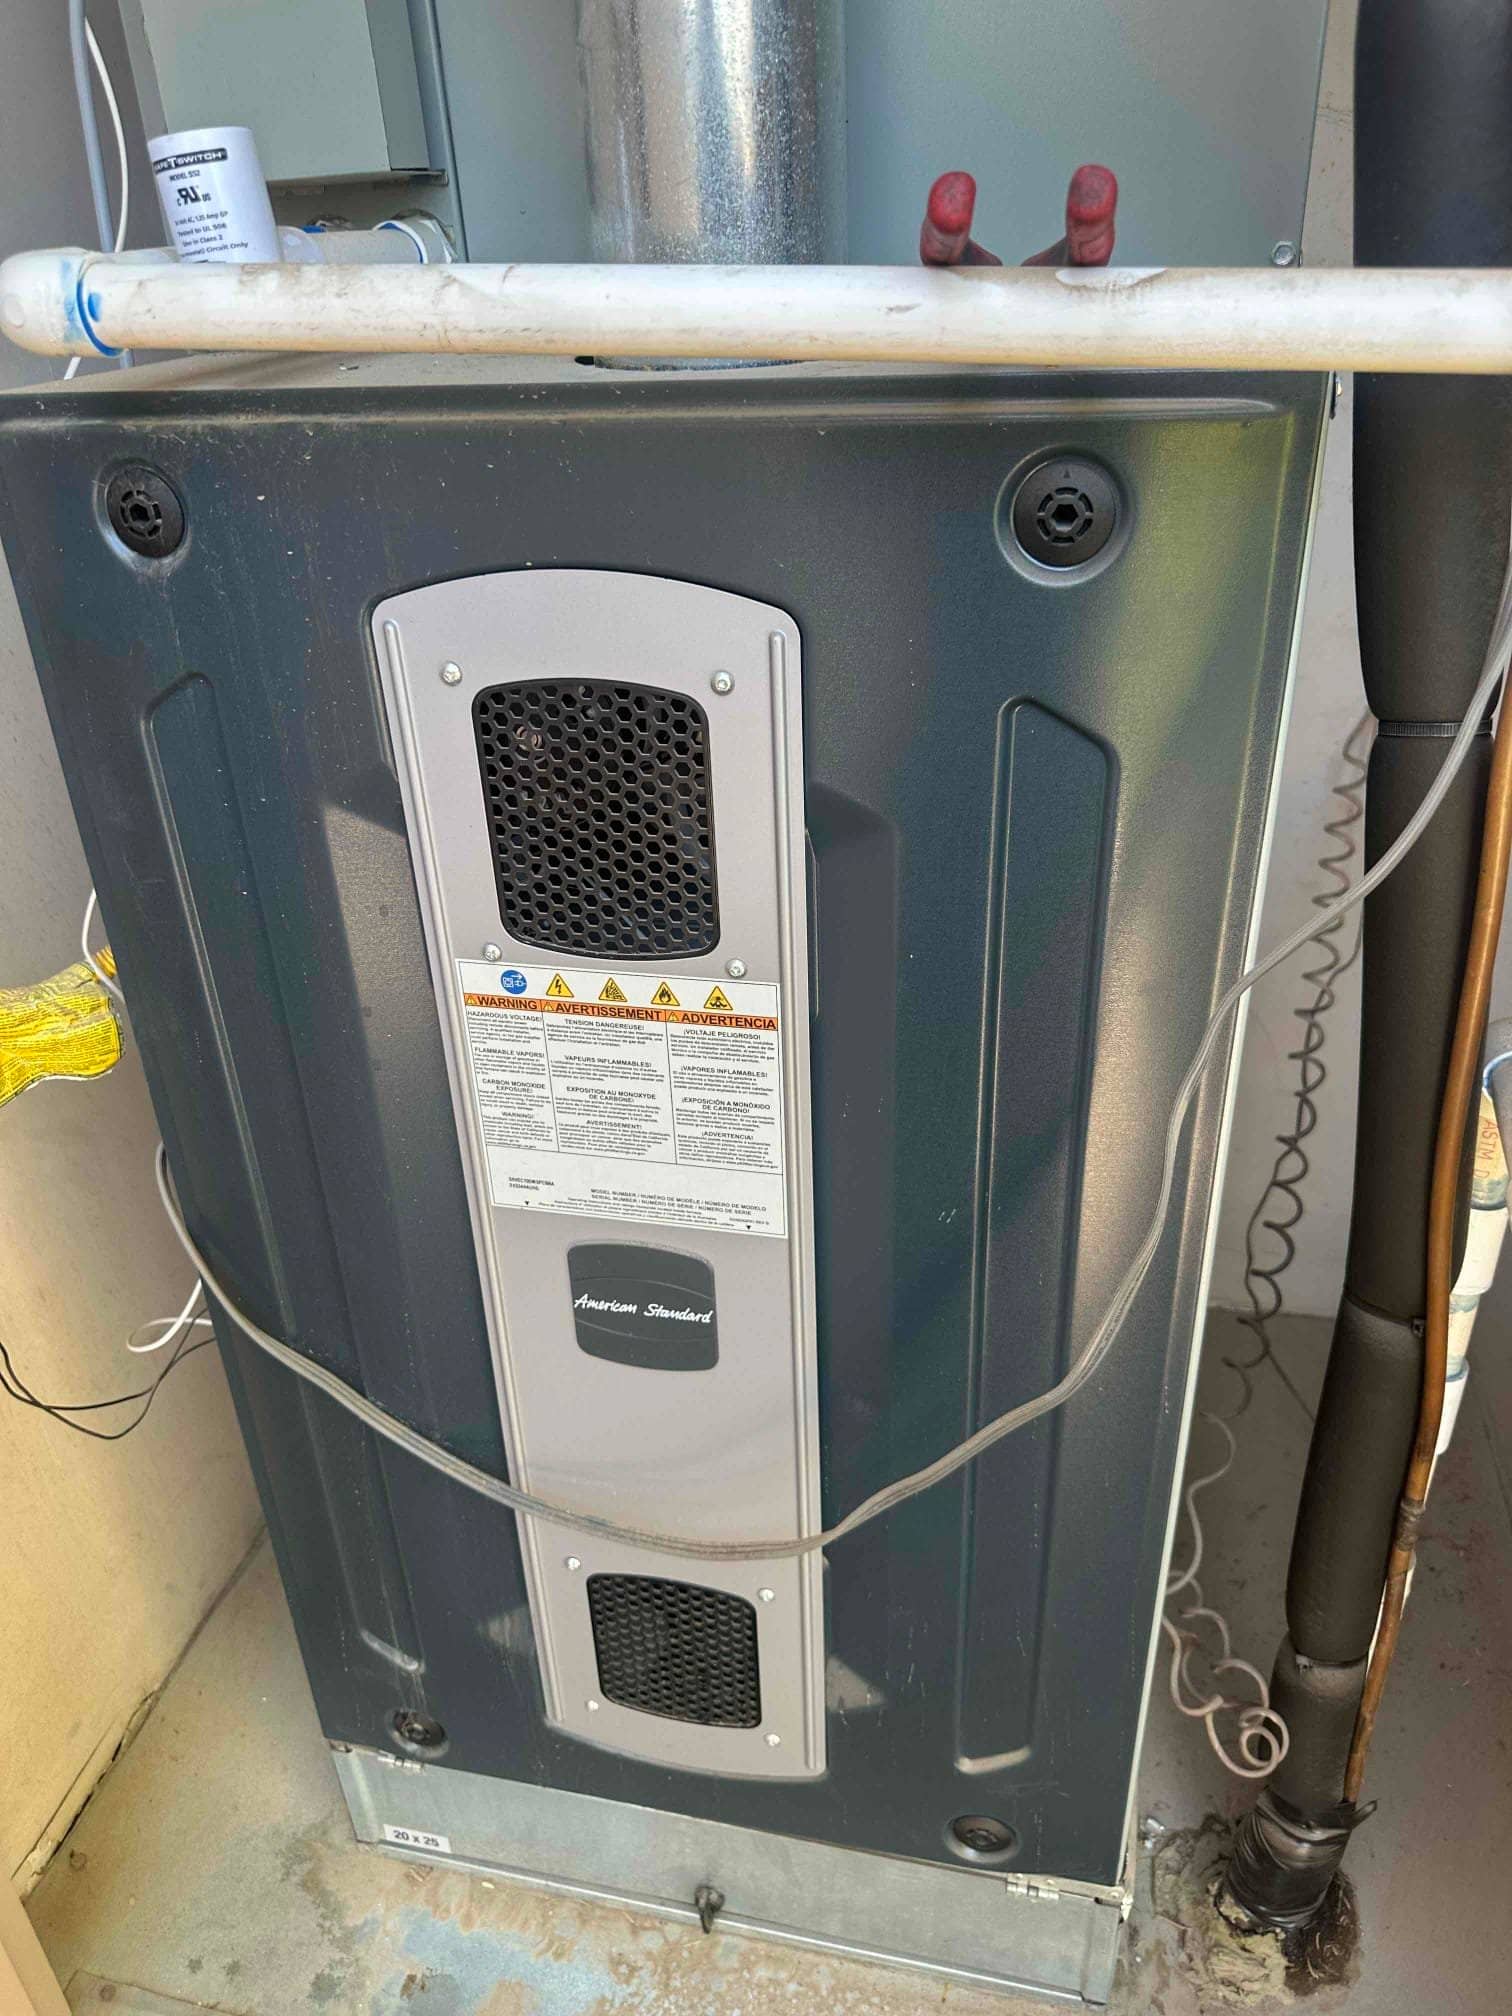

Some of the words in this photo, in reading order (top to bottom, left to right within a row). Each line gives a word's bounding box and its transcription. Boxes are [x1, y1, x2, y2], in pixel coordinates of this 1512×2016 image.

[169, 172, 188, 181] MODEL
[200, 236, 217, 244] Class
[206, 244, 229, 252] Circuit
[467, 1010, 508, 1020] HAZARDOUS
[510, 1014, 543, 1022] VOLTAGE!
[478, 996, 537, 1010] WARNING
[556, 1003, 662, 1020] AVERTISSEMENT
[682, 1013, 776, 1030] ADVERTENCIA
[564, 1018, 594, 1027] TENSION
[595, 1021, 644, 1031] DANGEREUSE!
[684, 1028, 716, 1036] ¡VOLTAJE
[718, 1032, 760, 1040] PELIGROSO!
[474, 1047, 514, 1056] FLAMMABLE
[564, 1055, 596, 1063] VAPEURS
[597, 1058, 652, 1068] INFLAMMABLES!
[716, 1068, 767, 1078] INFLAMABLES!
[482, 1078, 510, 1086] CARBON
[512, 1081, 546, 1090] MONOXIDE
[566, 1086, 606, 1095] EXPOSITION
[618, 1091, 656, 1100] MONOXYDE
[713, 1106, 750, 1114] CARBONO!
[733, 1101, 770, 1110] MONÓXIDO
[1479, 1120, 1500, 1160] ASTM
[573, 1293, 638, 1314] American
[643, 1304, 714, 1323] Standard
[393, 1830, 410, 1841] 20
[412, 1835, 420, 1843] x
[423, 1836, 440, 1847] 25
